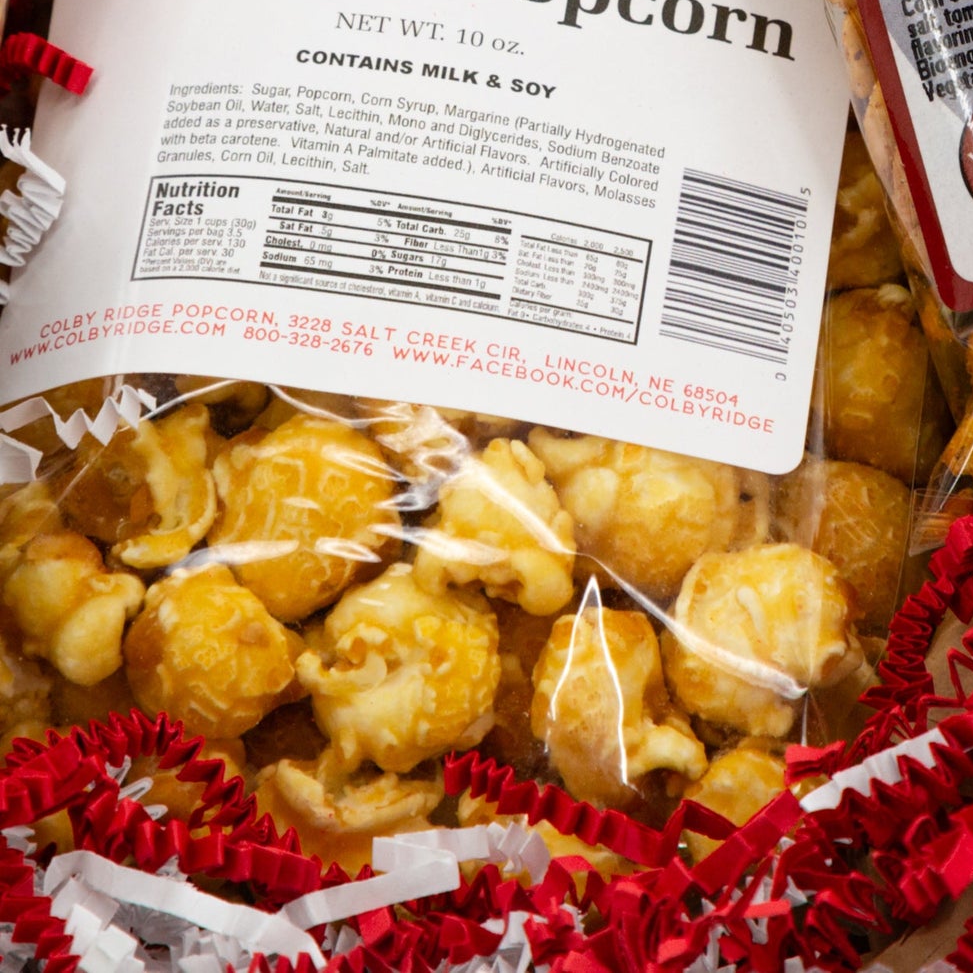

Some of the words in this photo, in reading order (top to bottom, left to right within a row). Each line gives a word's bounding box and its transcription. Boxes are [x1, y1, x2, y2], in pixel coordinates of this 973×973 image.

[335, 11, 391, 36] NET
[399, 19, 444, 42] WT.
[456, 29, 484, 47] 10
[492, 38, 525, 56] oz.
[296, 49, 414, 75] CONTAINS
[421, 61, 478, 85] MILK
[485, 71, 505, 88] &
[510, 75, 556, 100] SOY
[164, 117, 201, 129] added
[205, 118, 220, 128] as
[225, 119, 232, 128] a
[237, 118, 319, 134] preservative,
[325, 122, 370, 140] Natural
[375, 130, 419, 146] and/or
[422, 135, 476, 155] Artificial
[481, 146, 529, 166] Flavors.
[540, 156, 604, 181] Artificially
[609, 170, 658, 192] Colored
[167, 100, 220, 113] Soybean
[226, 100, 245, 112] Oil,
[251, 101, 290, 116] Water,
[296, 103, 323, 118] Salt,
[329, 106, 383, 125] Lecithin,
[389, 113, 426, 130] Mono
[431, 120, 454, 134] and
[459, 123, 542, 151] Diglycerides,
[548, 140, 597, 160] Sodium
[601, 152, 659, 174] Benzoate
[170, 83, 243, 97] Ingredients:
[252, 83, 291, 99] Sugar,
[297, 86, 355, 104] Popcorn,
[361, 92, 392, 107] Corn
[396, 96, 439, 116] Syrup,
[444, 104, 510, 127] Margarine
[515, 116, 571, 140] (Partially
[576, 129, 665, 159] Hydrogenated
[156, 182, 240, 198] Nutrition
[157, 149, 214, 163] Granules,
[221, 150, 251, 162] Corn
[256, 151, 276, 165] Oil,
[282, 153, 337, 172] Lecithin,
[342, 161, 369, 175] Salt.
[161, 134, 185, 146] with
[190, 133, 216, 145] beta
[221, 134, 280, 147] carotene.
[291, 137, 339, 153] Vitamin
[344, 143, 353, 155] A
[357, 144, 418, 165] Palmitate
[423, 153, 476, 174] added.),
[481, 164, 535, 184] Artificial
[539, 174, 588, 196] Flavors,
[594, 185, 656, 209] Molasses
[152, 201, 204, 216] Facts
[781, 287, 798, 344] 40503
[790, 220, 807, 277] 40010
[801, 187, 810, 195] 5
[9, 321, 226, 366] WWW.COLBYRIDGE.COM
[243, 326, 373, 356] 800-328-2676
[392, 345, 775, 434] WWW.FACEBOOK.COM/COLBYRIDGE
[40, 311, 95, 338] COLBY
[104, 304, 163, 322] RIDGE
[173, 304, 279, 328] POPCORN,
[288, 315, 331, 332] 3228
[342, 321, 397, 342] SALT
[407, 331, 476, 353] CREEK
[487, 343, 526, 364] CIR,
[545, 354, 639, 388] LINCOLN,
[648, 376, 674, 393] NE
[683, 383, 738, 408] 68504
